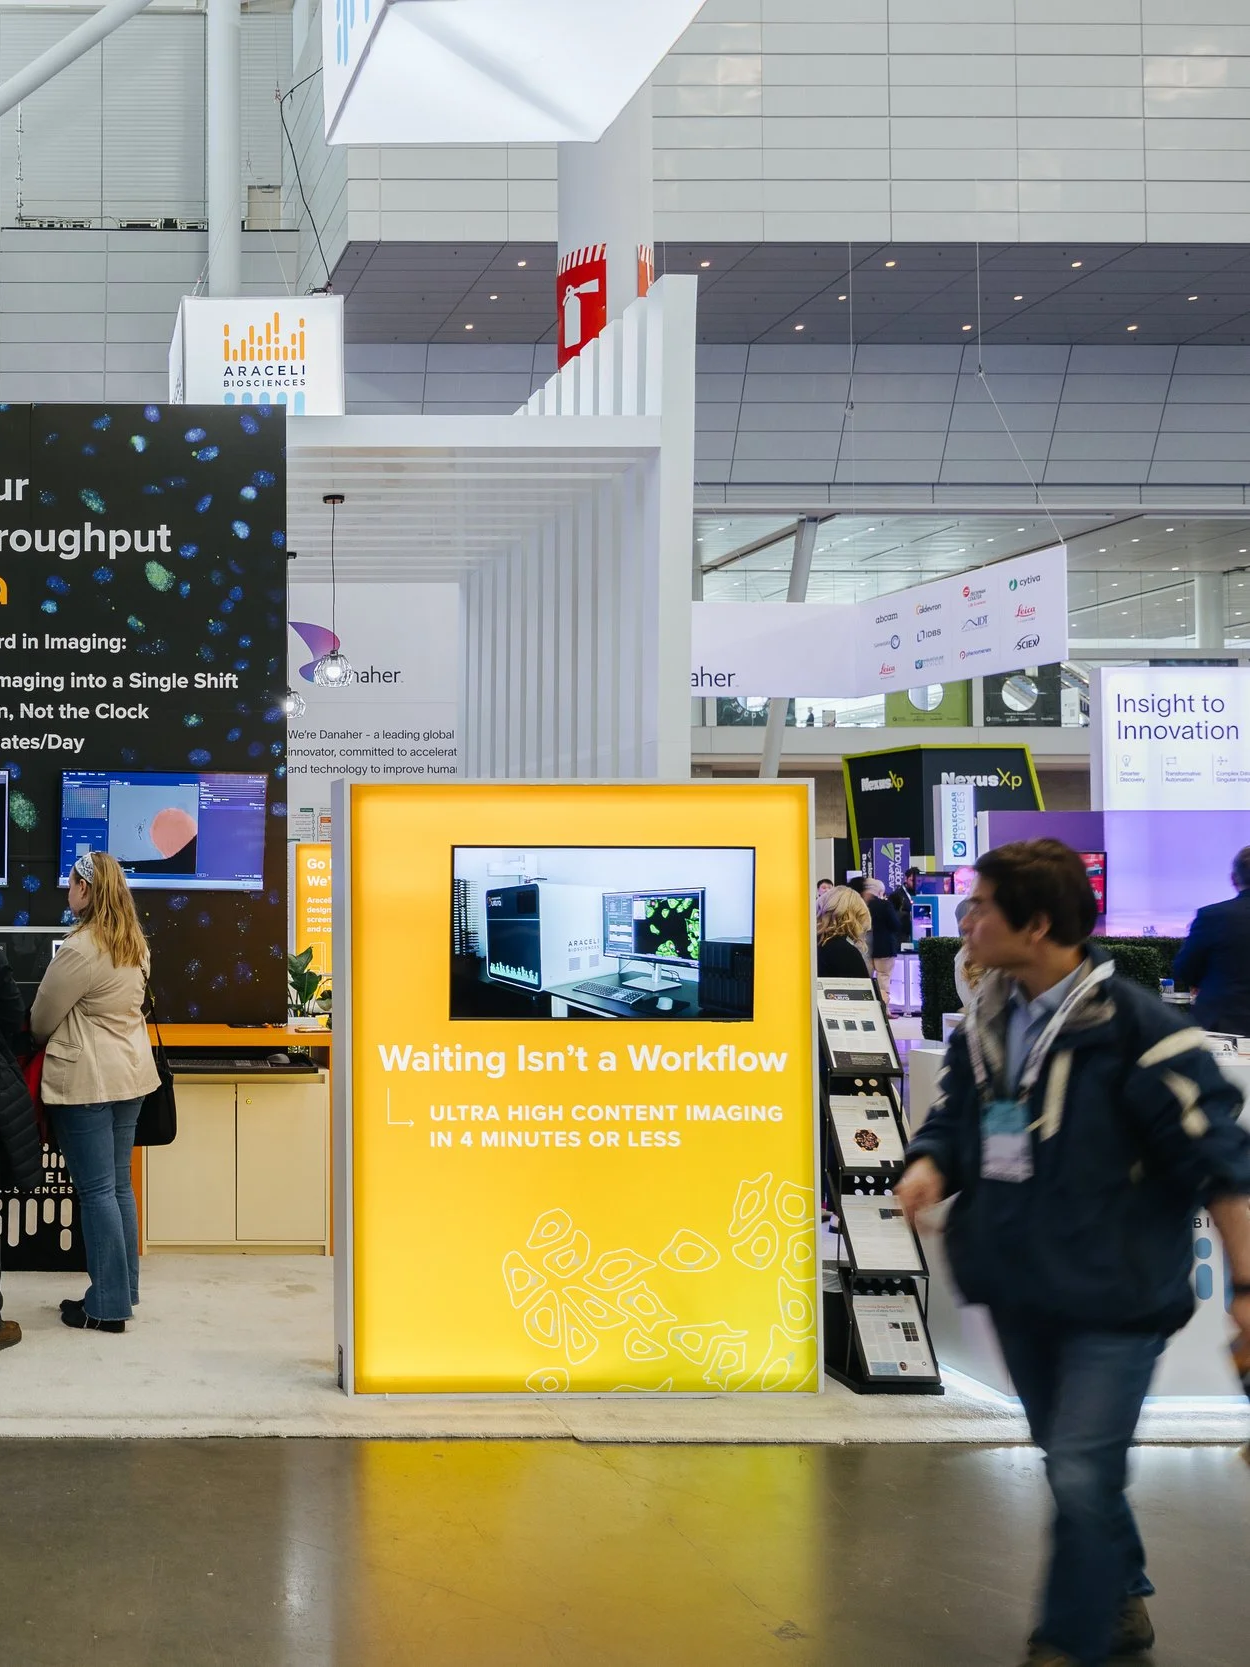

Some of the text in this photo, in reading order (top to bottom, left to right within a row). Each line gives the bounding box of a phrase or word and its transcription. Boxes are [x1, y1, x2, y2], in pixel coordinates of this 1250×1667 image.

[223, 364, 305, 377] ARACELI
[223, 378, 306, 388] BIOSCIENCES
[1019, 574, 1041, 587] cytiva
[876, 612, 898, 624] abcam
[1015, 604, 1036, 618] Leica
[926, 629, 942, 638] IDBS
[22, 633, 39, 650] in
[44, 633, 127, 654] Imaging:
[1017, 639, 1038, 650] SCIEX
[70, 671, 107, 689] into
[112, 676, 124, 689] a
[129, 671, 189, 693] Single
[193, 671, 239, 689] Shift
[19, 702, 54, 719] Not
[59, 702, 90, 719] the
[95, 702, 150, 719] Clock
[1117, 693, 1225, 718] Insight to
[319, 729, 363, 740] Danaher
[374, 732, 380, 740] a
[382, 729, 421, 742] leading
[422, 729, 455, 742] global
[1117, 720, 1239, 740] Innovation
[287, 746, 337, 758] innovator,
[339, 746, 395, 757] committed
[397, 747, 408, 757] to
[287, 763, 308, 774] and
[310, 763, 368, 777] technology
[370, 765, 381, 774] to
[383, 763, 425, 777] improve
[860, 770, 904, 792] NexusXp
[940, 767, 1023, 791] NexusXp
[1119, 776, 1146, 784] Discovery
[957, 790, 965, 840] DEVICES
[306, 858, 326, 870] Go
[306, 924, 321, 933] and
[568, 938, 600, 947] ARACELI
[377, 1043, 506, 1079] Waiting
[597, 1051, 617, 1072] a
[627, 1044, 788, 1073] Workflow
[429, 1104, 783, 1123] ULTRA HIGH CONTENT IMAGING
[429, 1130, 681, 1148] IN 4 MINUTES OR LESS
